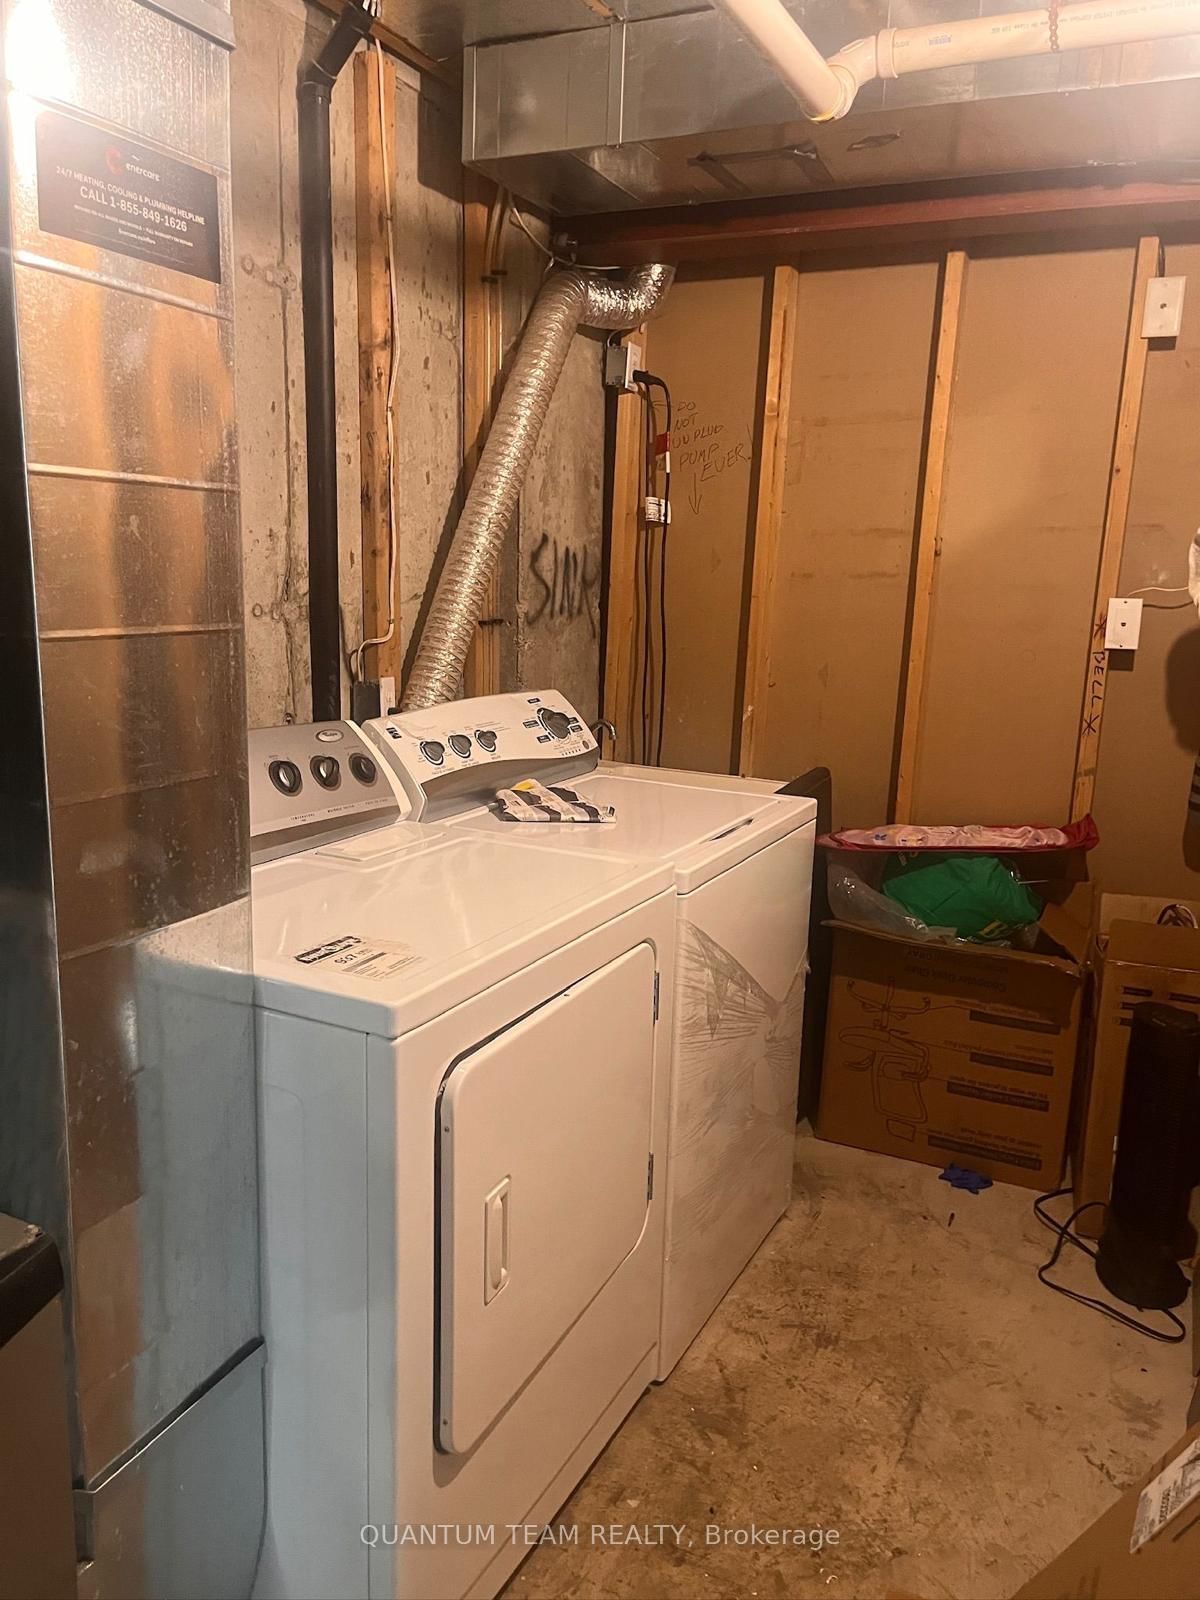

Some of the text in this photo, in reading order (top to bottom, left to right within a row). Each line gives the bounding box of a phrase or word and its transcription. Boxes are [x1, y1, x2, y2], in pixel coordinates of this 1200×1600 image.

[56, 165, 73, 179] 24/7
[107, 183, 138, 201] COOLING
[144, 196, 177, 215] PLUMBING
[177, 208, 206, 226] HELPLINE
[80, 186, 108, 206] CALL
[110, 196, 188, 233] 1-855-849-1626
[674, 412, 699, 433] NOT
[677, 401, 697, 412] DO
[679, 442, 720, 473] PUMP
[526, 532, 600, 640] SINK
[1091, 651, 1106, 708] BELL
